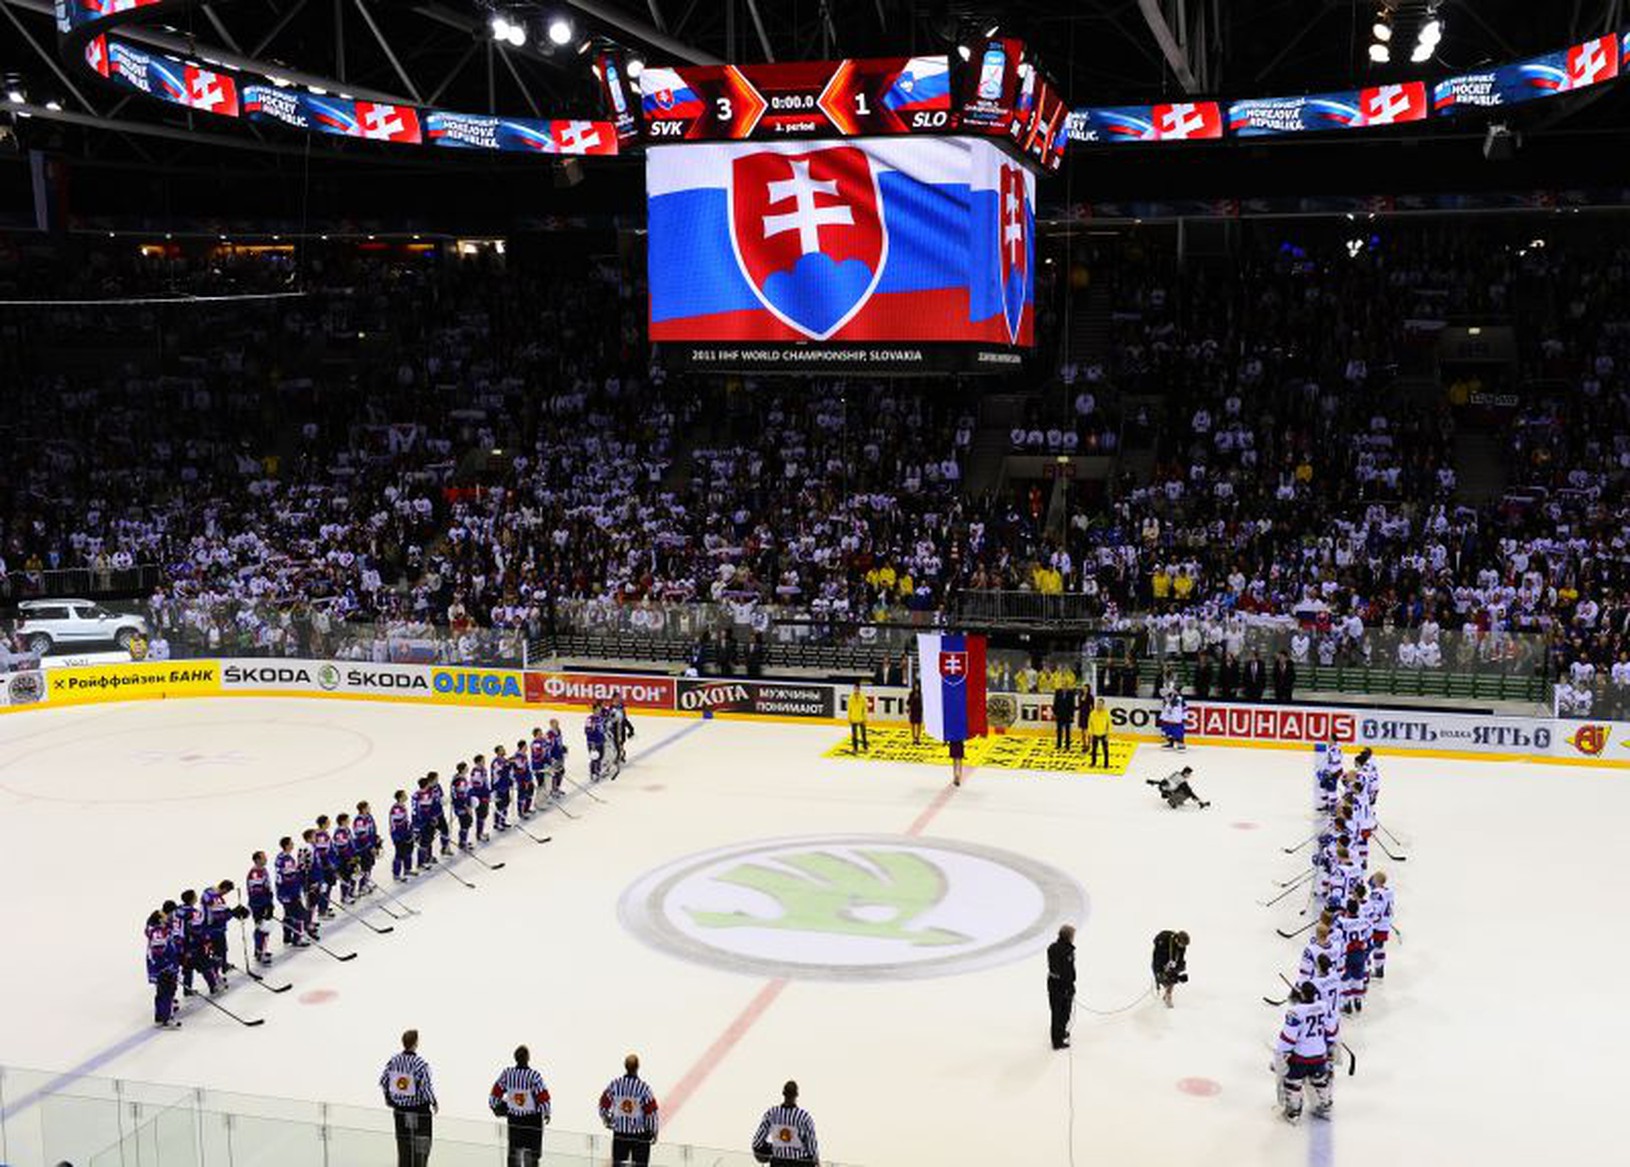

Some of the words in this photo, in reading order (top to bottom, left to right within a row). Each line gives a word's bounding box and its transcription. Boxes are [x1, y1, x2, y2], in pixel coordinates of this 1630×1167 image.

[716, 98, 733, 120] 3
[771, 96, 814, 110] 0:00.0
[854, 92, 871, 116] 1
[650, 120, 683, 136] SVK
[785, 121, 816, 134] period
[912, 111, 947, 128] SLO
[692, 349, 717, 361] 2011
[718, 349, 740, 361] IIHF
[741, 350, 780, 361] WORLD
[869, 349, 922, 361] SLOVAKIA
[68, 673, 166, 690] Райффайзен
[169, 669, 214, 683] БАНК
[224, 665, 311, 683] ŠKODA
[347, 670, 428, 689] ŠKODA
[433, 671, 522, 697] OJEGA
[680, 684, 749, 709] ОХОТА
[758, 687, 822, 701] МУЖЧИНЫ
[755, 700, 824, 715] ПОНИМАЮТ
[1184, 709, 1353, 740] BAUHAUS
[1305, 1013, 1326, 1038] 25
